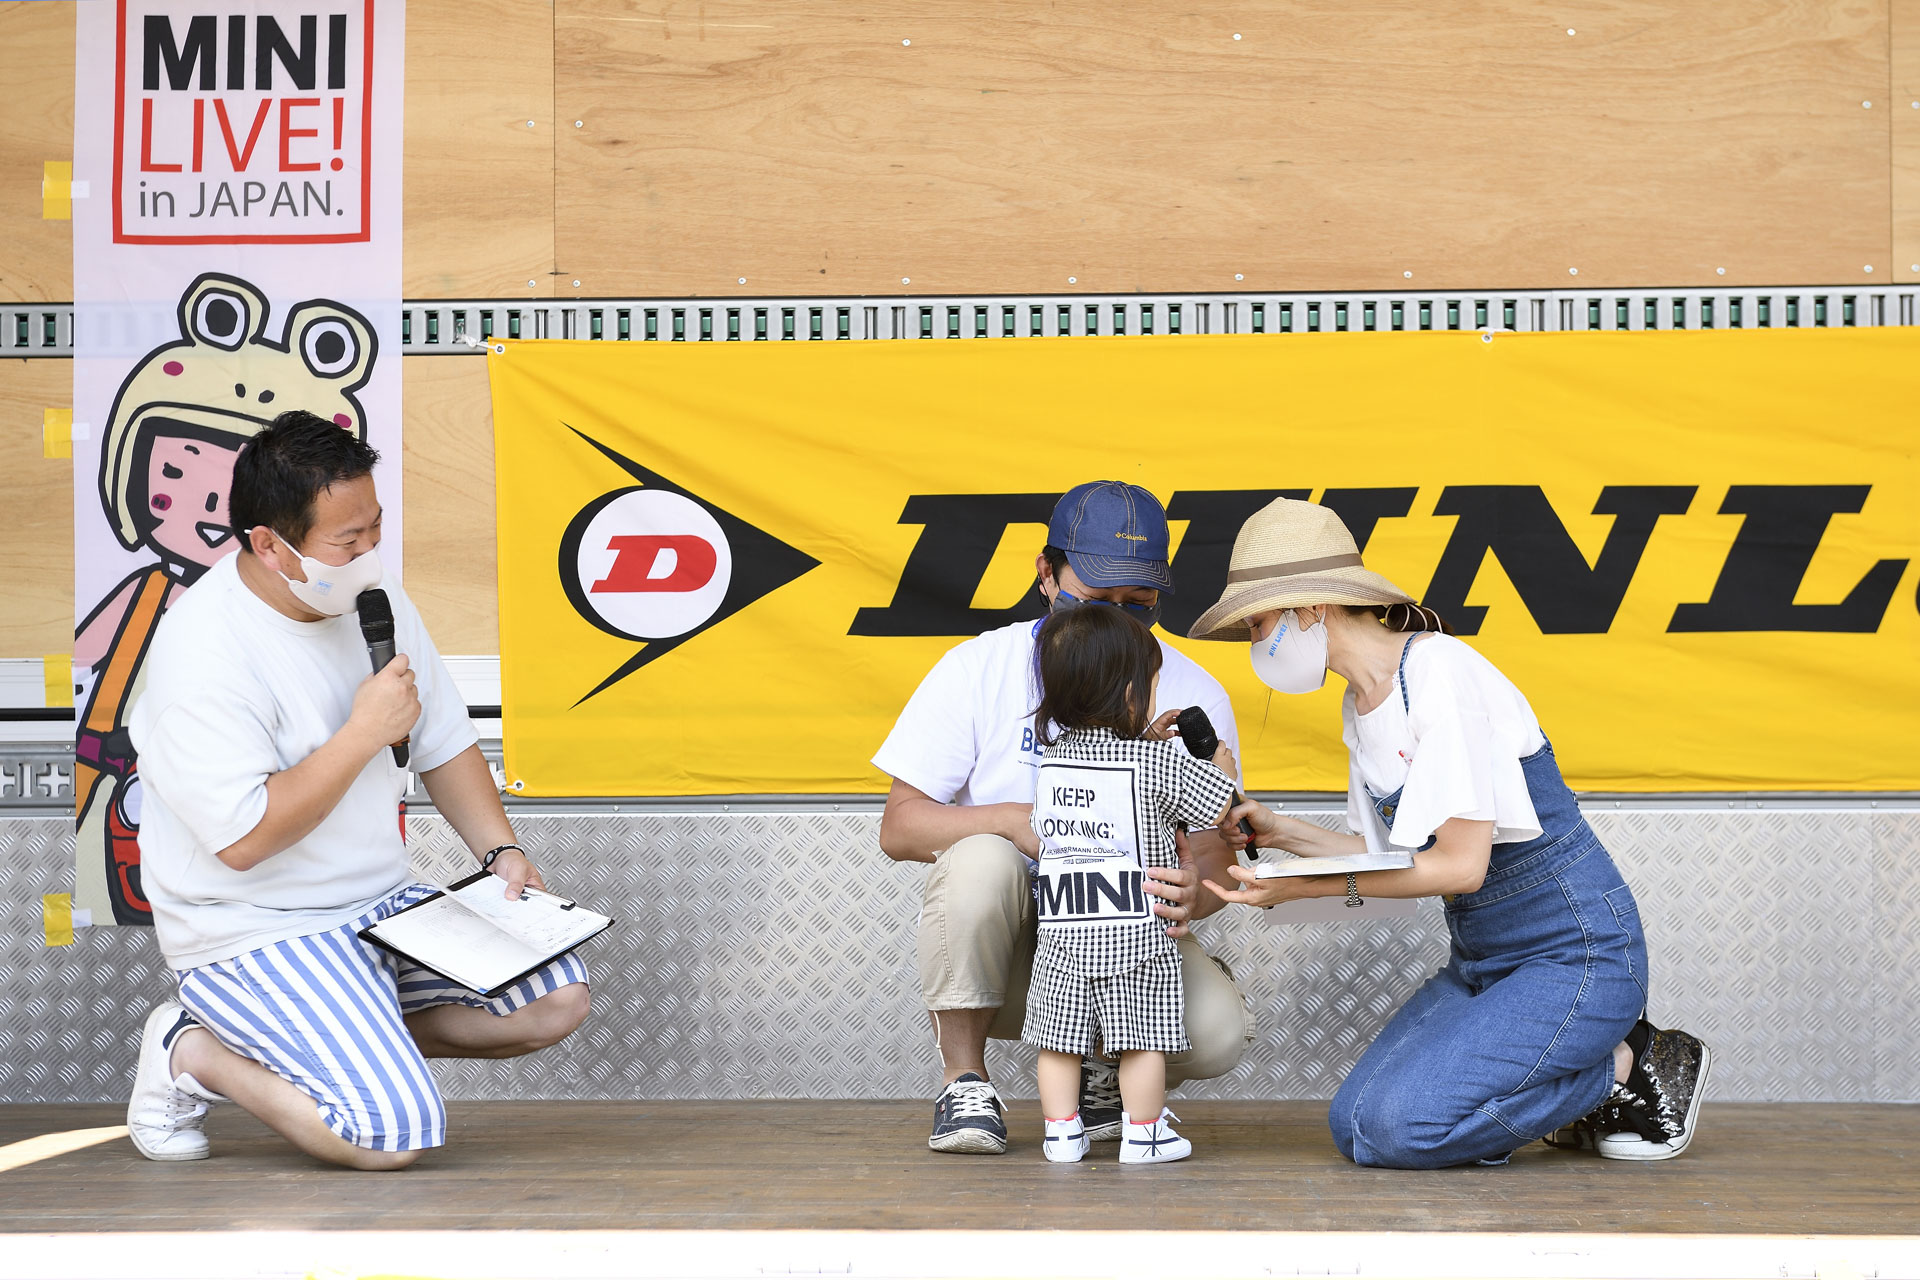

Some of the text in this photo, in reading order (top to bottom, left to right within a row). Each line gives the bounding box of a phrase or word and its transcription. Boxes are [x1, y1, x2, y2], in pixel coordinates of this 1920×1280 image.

[142, 14, 347, 91] MINI
[140, 97, 345, 173] LIVE!
[139, 179, 345, 218] in JAPAN.
[590, 534, 718, 594] D
[847, 484, 1920, 638] DUNL
[1052, 786, 1096, 809] KEEP
[1038, 870, 1145, 917] MINI
